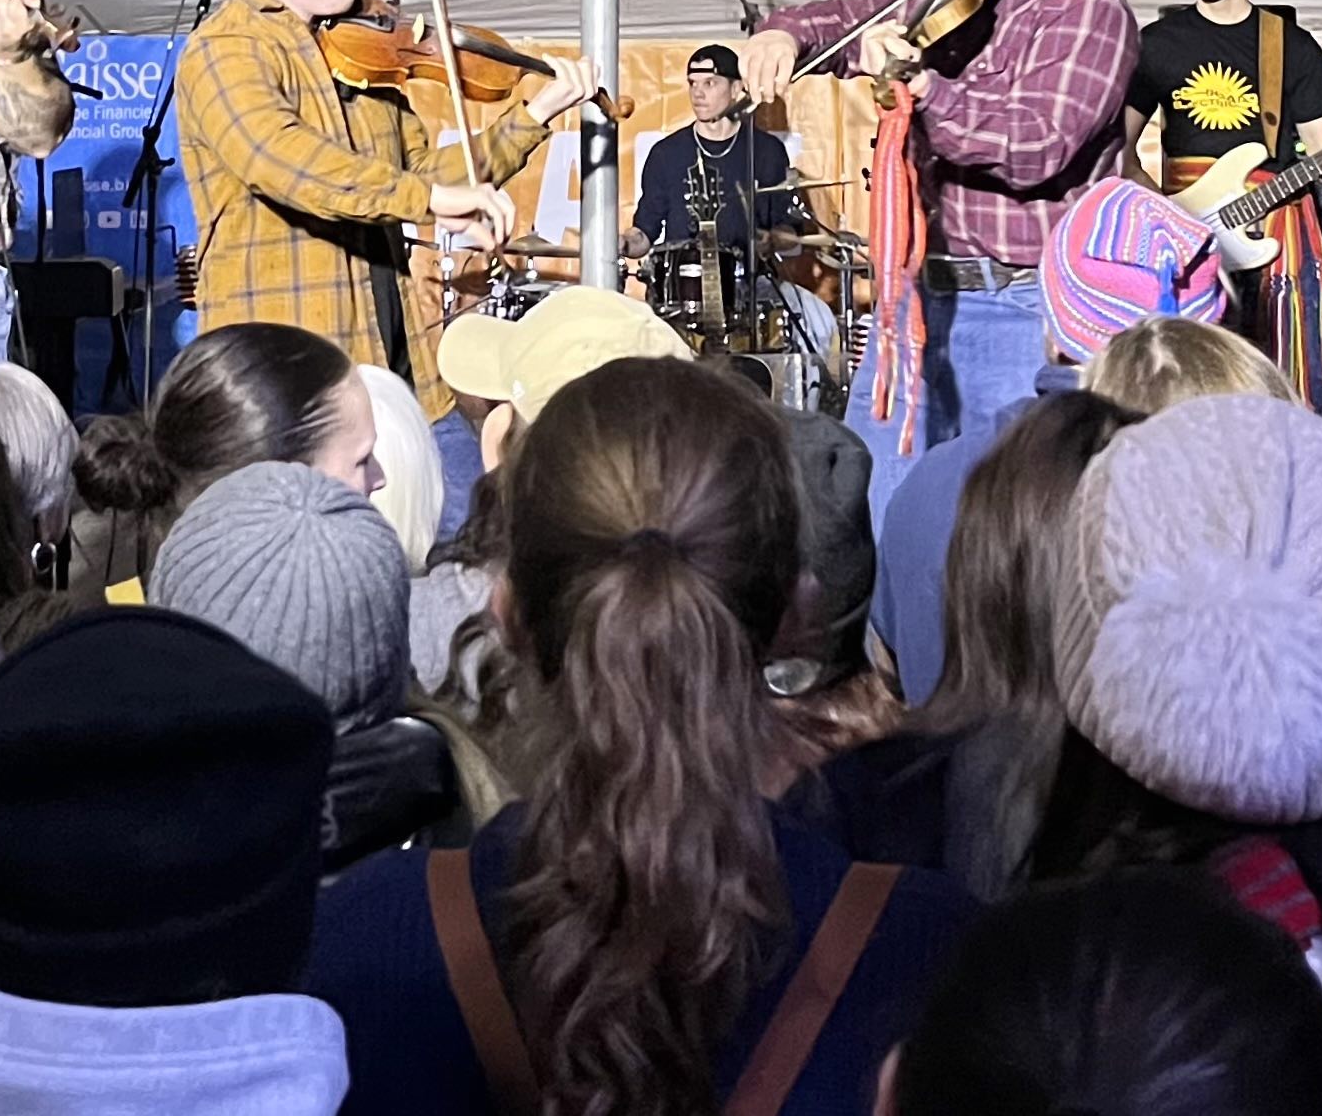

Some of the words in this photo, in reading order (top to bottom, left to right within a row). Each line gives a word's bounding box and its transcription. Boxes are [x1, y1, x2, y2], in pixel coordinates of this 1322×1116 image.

[58, 44, 162, 100] aisse
[94, 105, 154, 120] Financie
[109, 123, 143, 139] Grou
